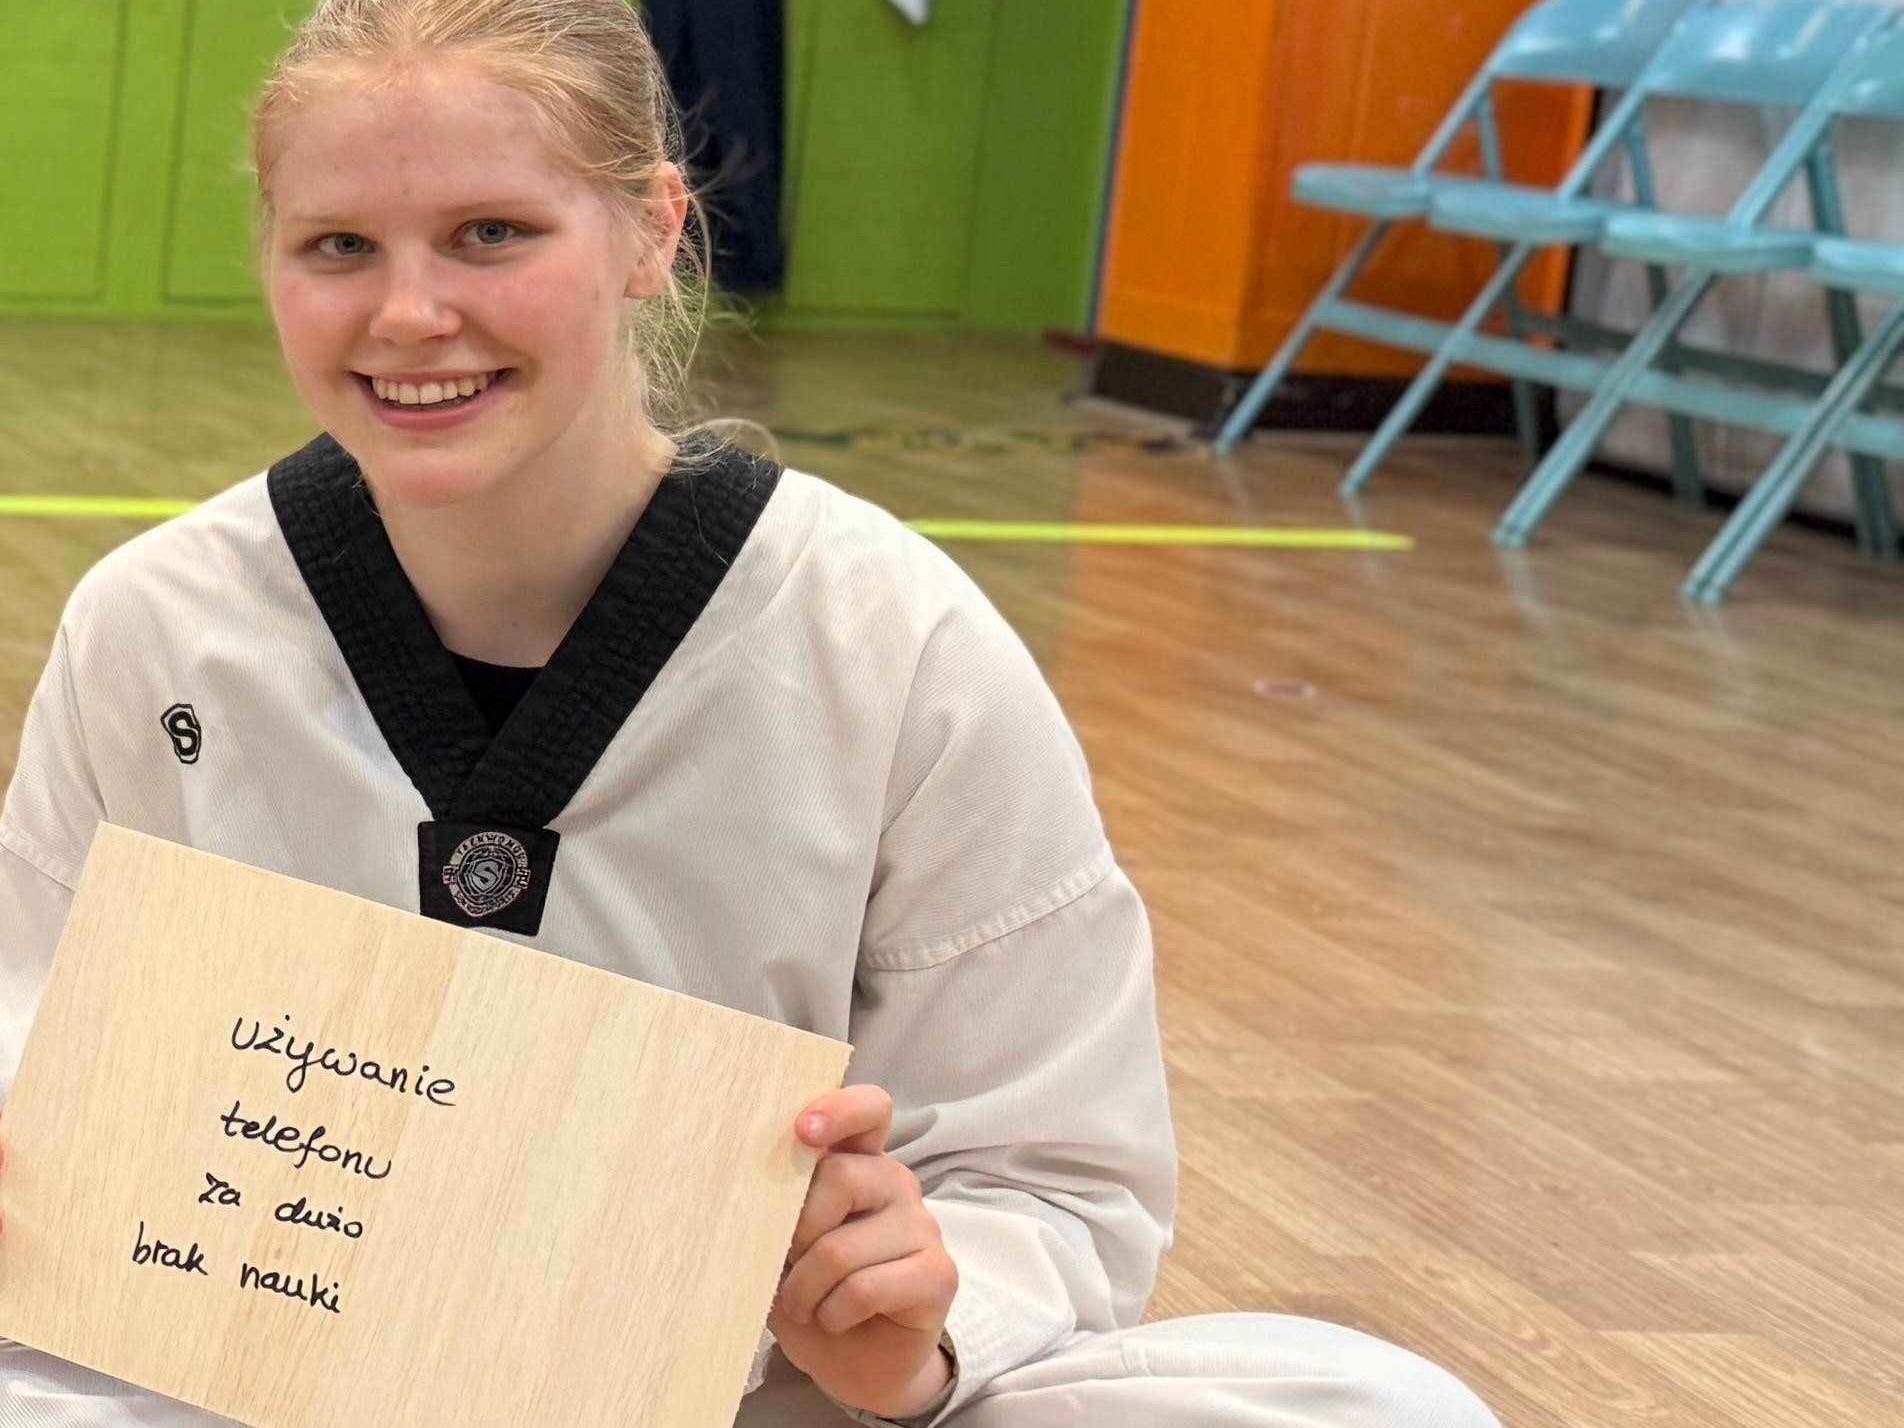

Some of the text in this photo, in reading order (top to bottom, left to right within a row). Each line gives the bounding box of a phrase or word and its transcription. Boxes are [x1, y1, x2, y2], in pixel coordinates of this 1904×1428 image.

[220, 1100, 392, 1180] telefonu
[274, 1197, 364, 1239] dużo
[131, 1220, 341, 1314] brak nauki
